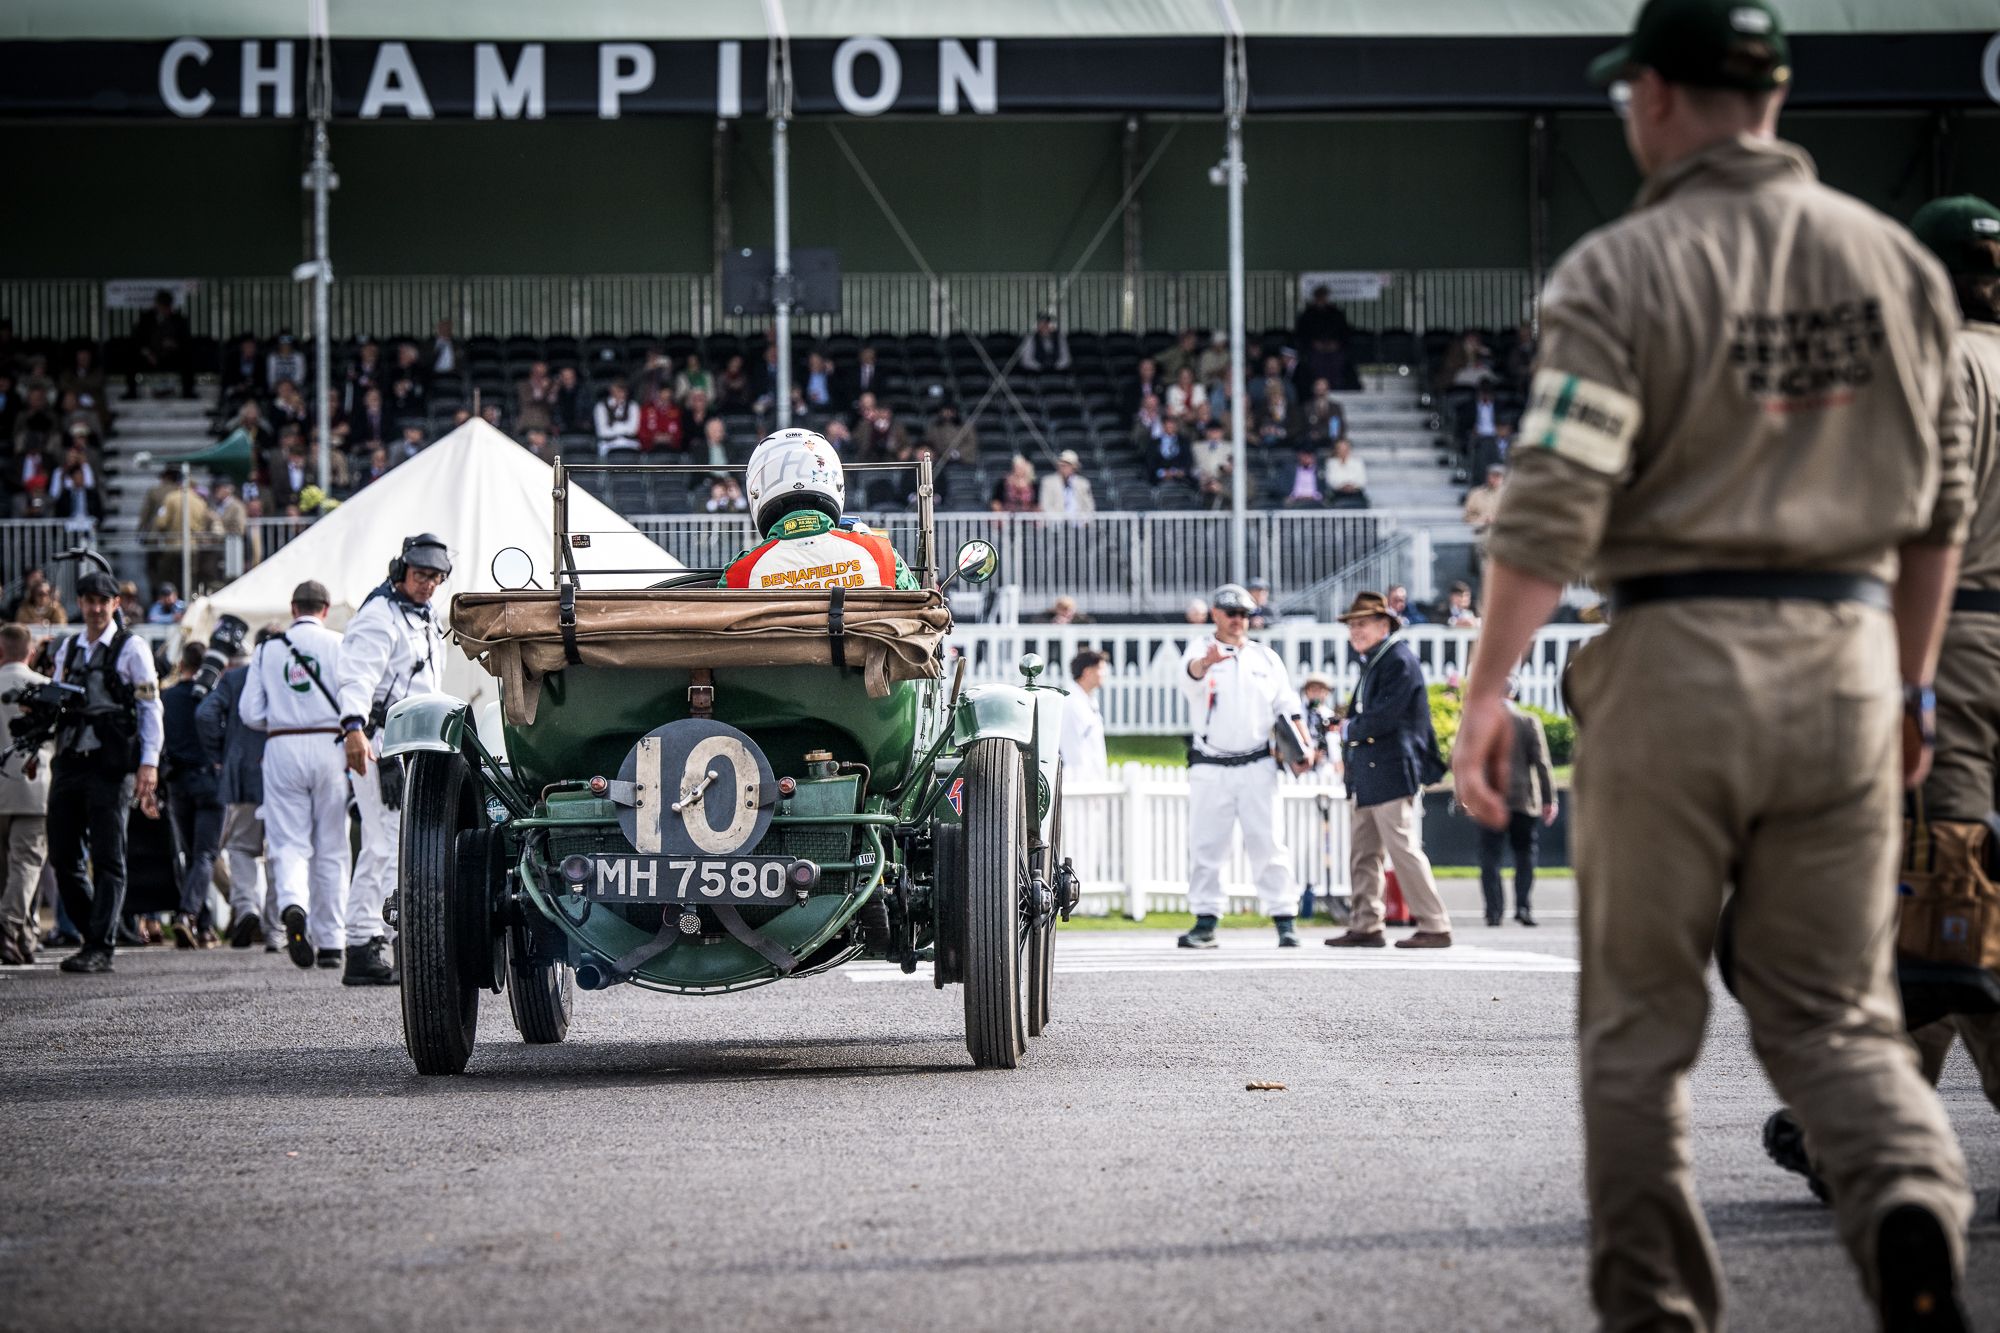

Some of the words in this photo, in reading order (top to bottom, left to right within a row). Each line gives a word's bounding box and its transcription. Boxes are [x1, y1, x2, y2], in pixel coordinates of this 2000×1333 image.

[158, 36, 998, 119] CHAMPION
[761, 560, 861, 588] BENJAFIELD'S
[825, 574, 864, 588] CLUB
[636, 736, 760, 854] 10
[597, 859, 657, 896] MH
[669, 861, 786, 898] 7580
